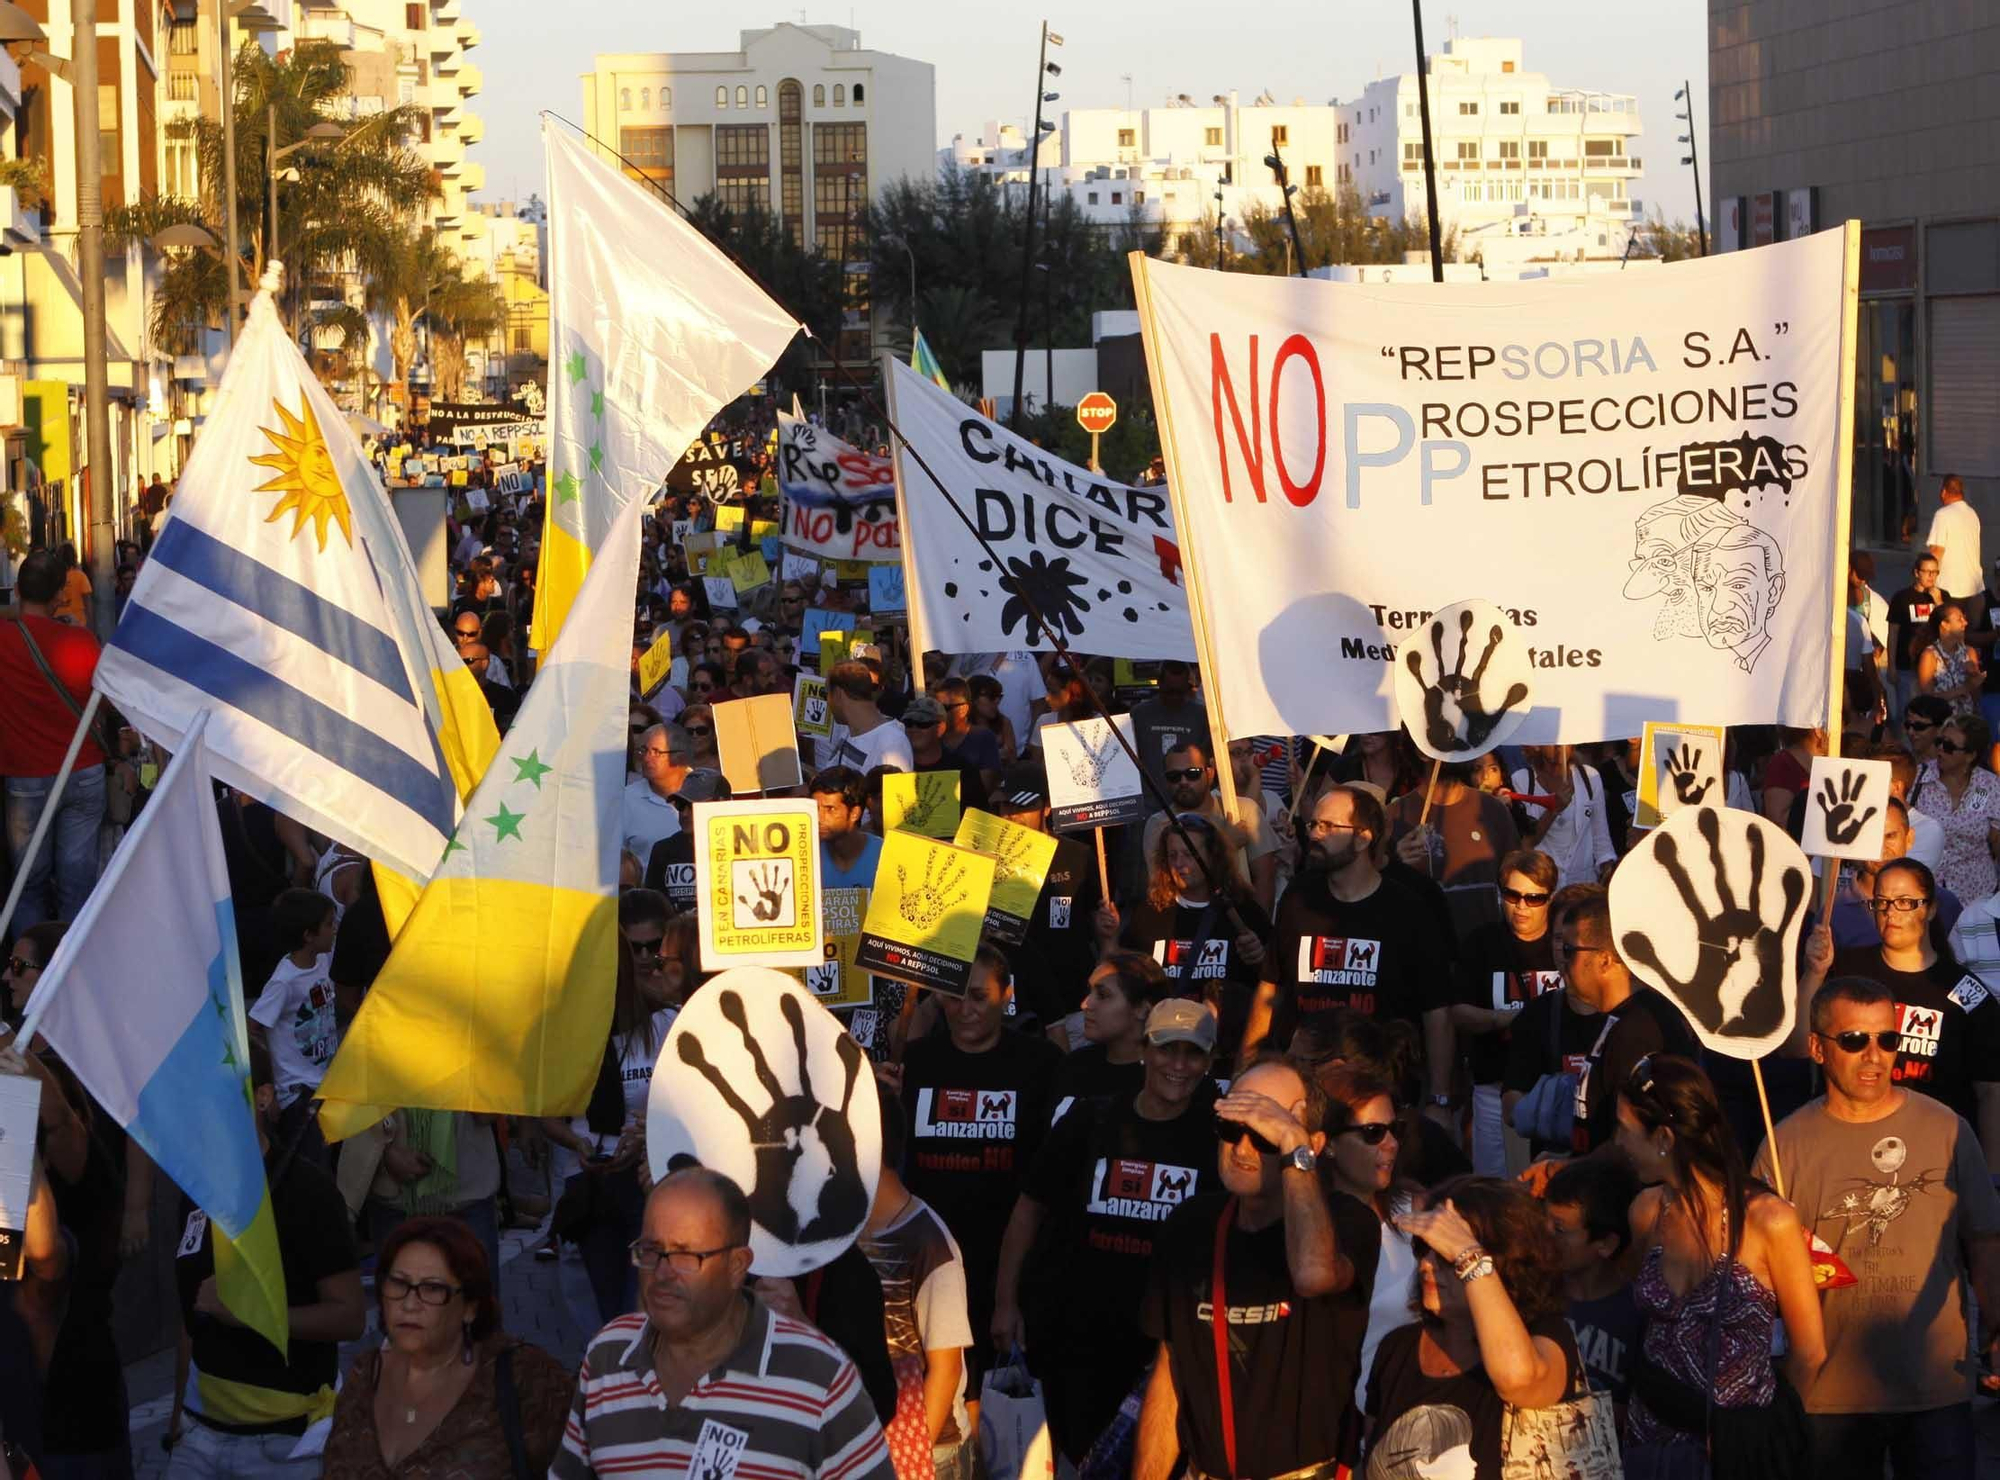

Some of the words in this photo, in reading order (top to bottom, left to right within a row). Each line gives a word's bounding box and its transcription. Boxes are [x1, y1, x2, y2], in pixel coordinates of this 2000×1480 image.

[1081, 407, 1113, 418] STOP
[1210, 333, 1326, 507] NO
[492, 423, 540, 440] REPPSOL
[685, 441, 742, 463] SAVE
[500, 473, 519, 493] NO
[975, 488, 1130, 560] DICE
[1075, 812, 1088, 821] NO
[733, 822, 790, 854] NO
[665, 865, 696, 884] NO
[715, 827, 729, 907] CANARIAS
[799, 823, 810, 929] PROSPECCIONES
[719, 911, 730, 932] EN
[719, 932, 811, 947] PETROLÍFERAS
[867, 938, 884, 949] AQUÍ
[884, 943, 912, 957] VIVIMOS,
[886, 952, 900, 963] NO
[900, 957, 907, 965] A
[907, 959, 939, 974] REPPSOL
[1298, 936, 1377, 987] Lanzarote
[915, 1088, 1015, 1139] Lanzarote
[709, 1426, 744, 1450] NO!
